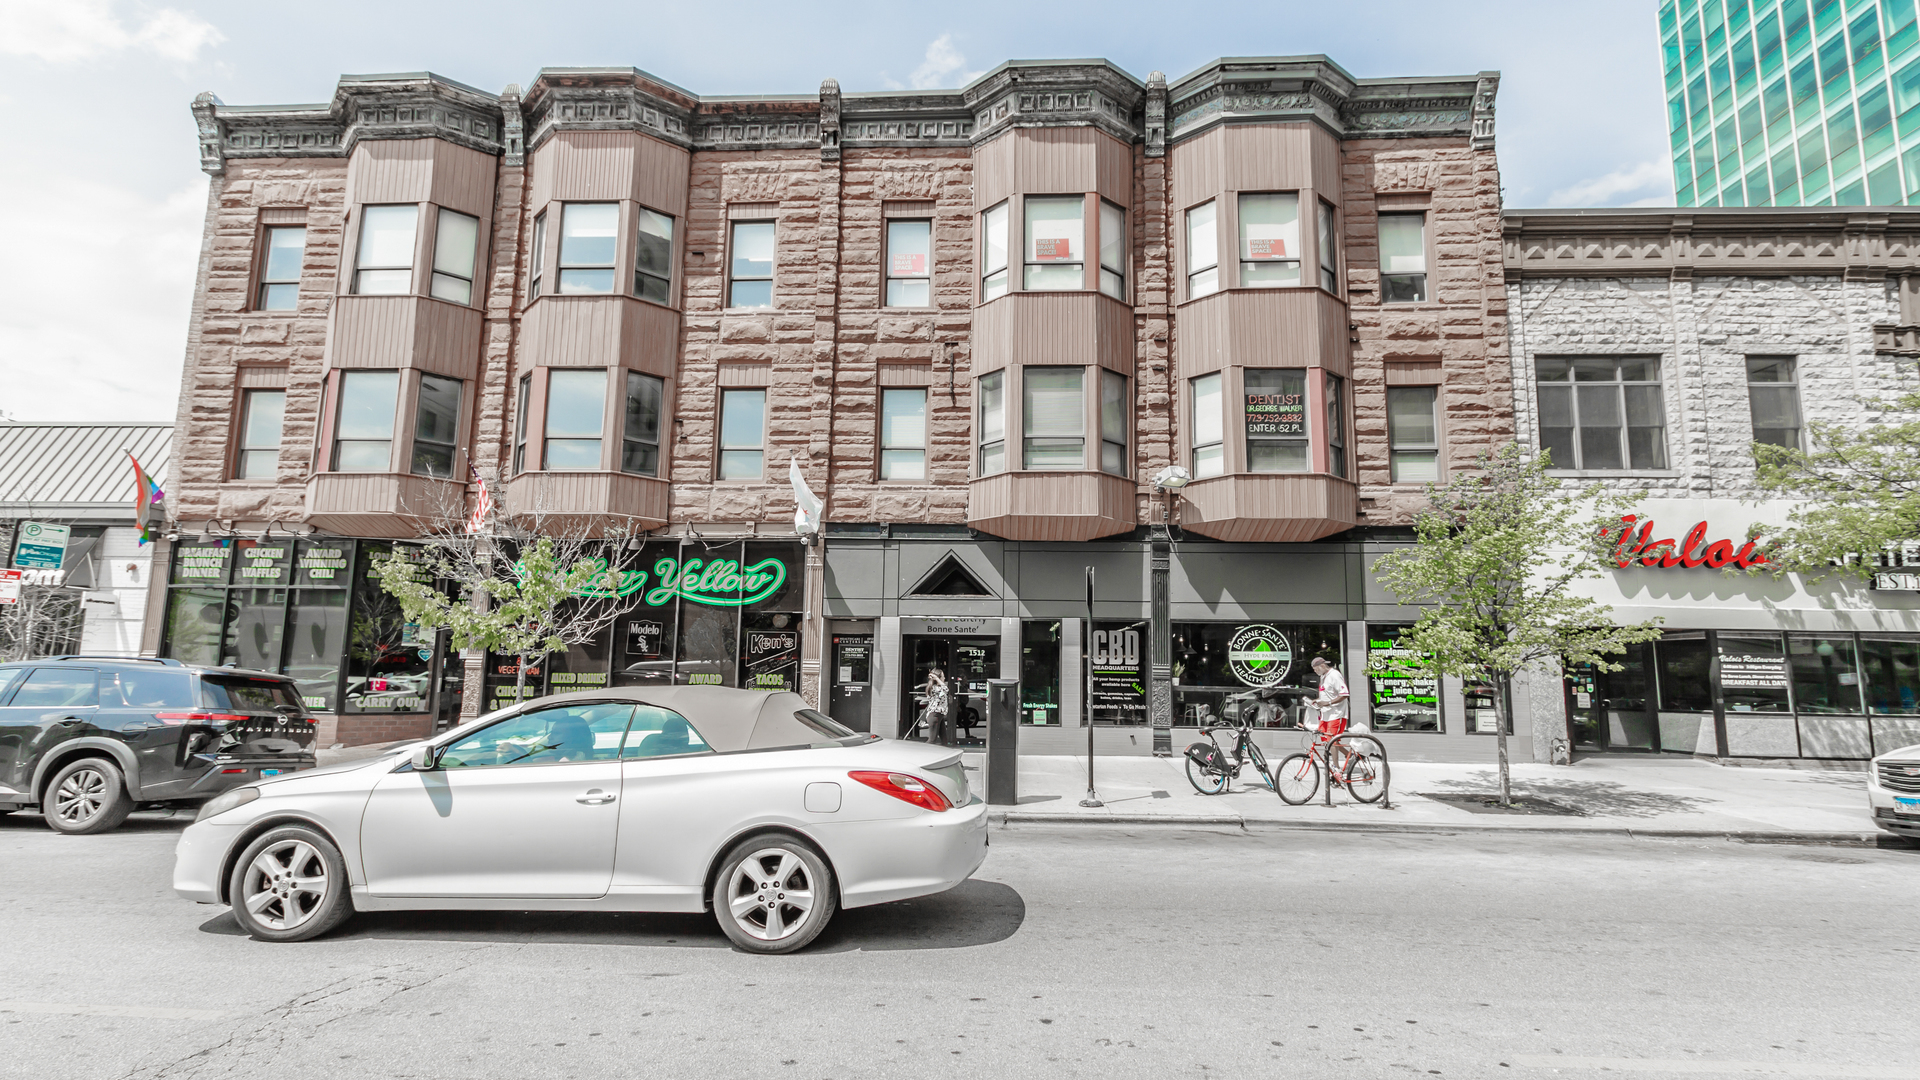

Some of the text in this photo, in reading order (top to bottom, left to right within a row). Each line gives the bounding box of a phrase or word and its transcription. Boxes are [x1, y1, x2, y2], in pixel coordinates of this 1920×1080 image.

[1248, 394, 1301, 405] DENTIST
[1248, 424, 1276, 433] ENTER
[178, 548, 231, 558] BREAKFAST
[244, 548, 284, 558] CHICKEN
[305, 549, 342, 558] AWARD
[183, 558, 223, 568] BRUNCH
[251, 558, 274, 568] AND
[299, 558, 347, 568] WINNING
[182, 568, 221, 578] DINNER
[242, 567, 281, 578] WAFFLES
[309, 569, 335, 578] CHILI
[646, 557, 787, 606] Yellow
[630, 623, 660, 635] Modelo
[927, 625, 952, 633] Bonne
[750, 634, 794, 653] Ken's
[1233, 630, 1259, 650] BONNE
[1370, 638, 1392, 648] local
[1092, 630, 1139, 665] CBD
[1743, 655, 1785, 663] Restaurant
[551, 672, 607, 684] MIXED DRINKS
[688, 673, 723, 685] AWARD
[756, 673, 784, 685] TACOS
[1235, 665, 1286, 683] HEALTH FOODS
[495, 685, 535, 697] CHICEN
[1131, 682, 1146, 695] SALE
[1392, 686, 1413, 696] juice
[1413, 686, 1428, 694] bar
[355, 696, 420, 708] CARRY OUT
[489, 699, 499, 711] &
[236, 726, 314, 734] PATHFINDER
